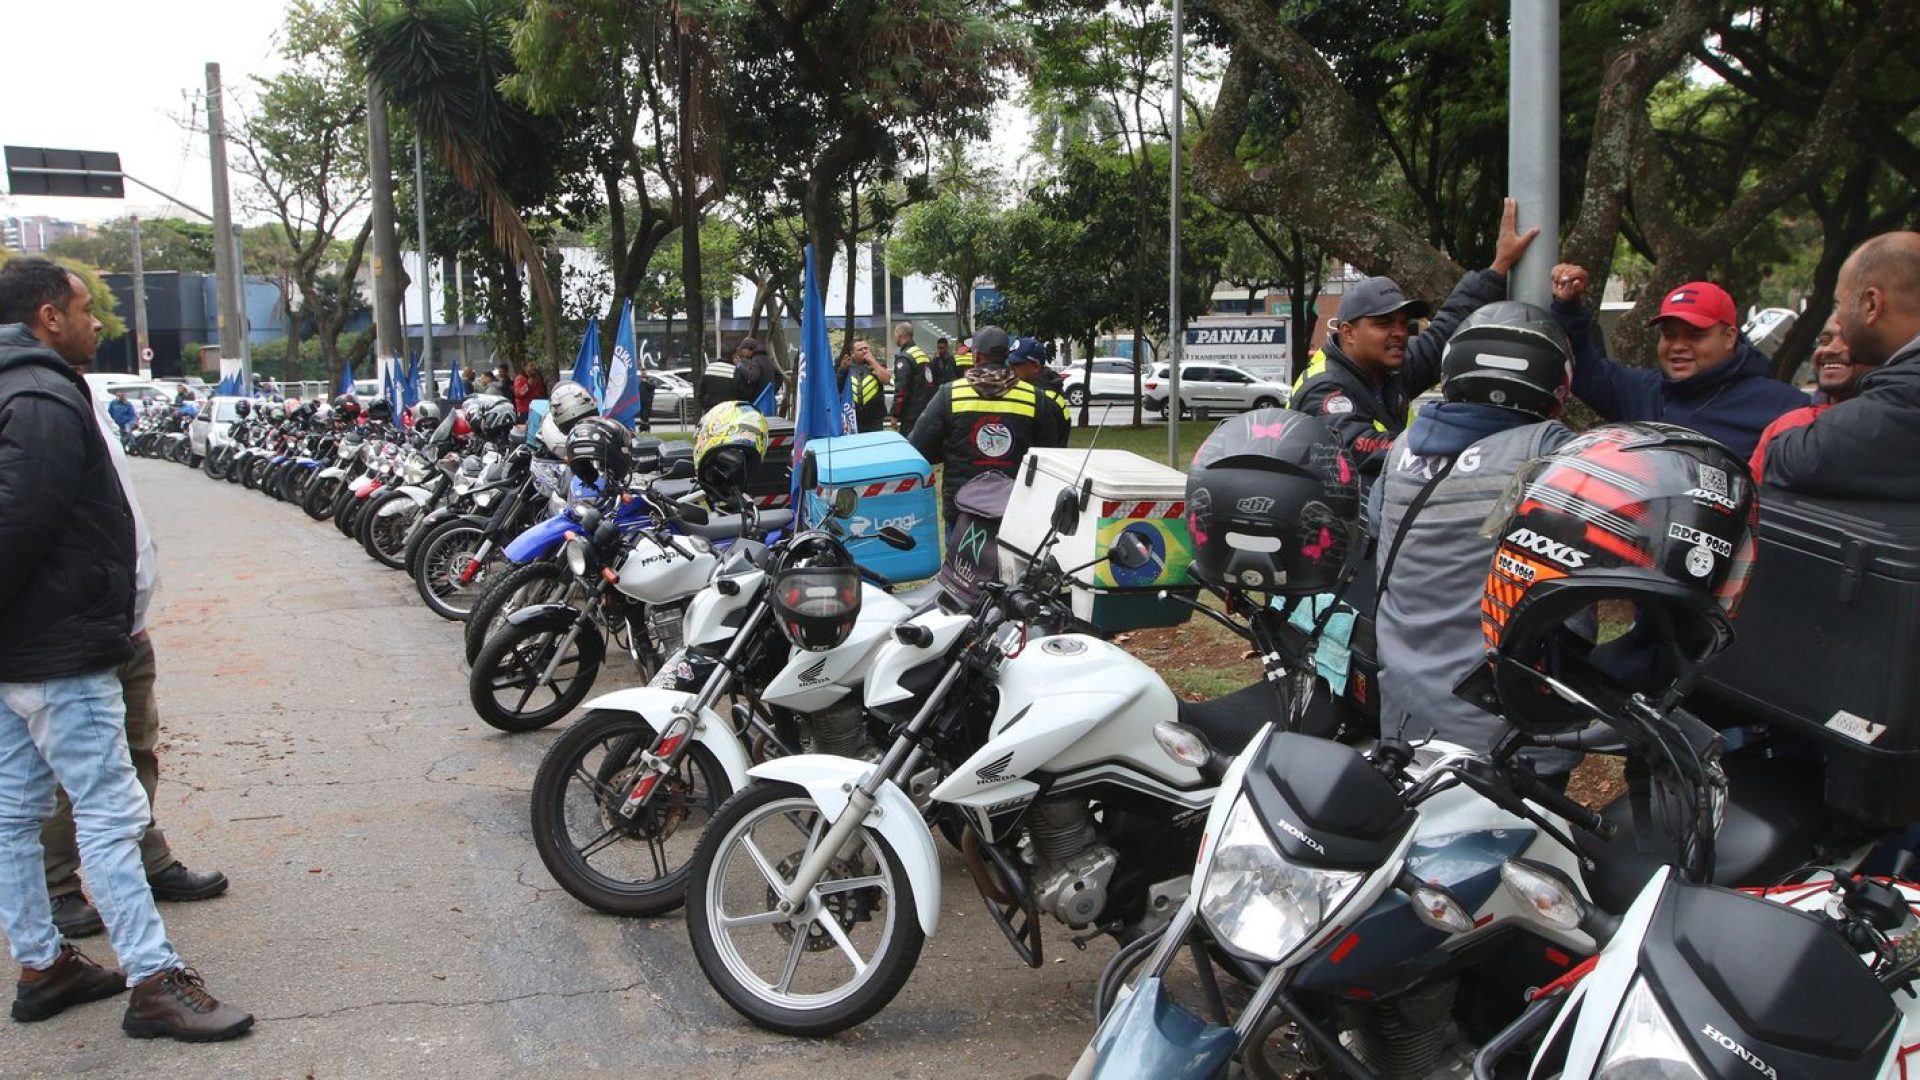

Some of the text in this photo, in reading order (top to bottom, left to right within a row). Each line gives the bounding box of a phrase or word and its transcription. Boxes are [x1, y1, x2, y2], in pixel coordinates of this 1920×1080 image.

[1196, 329, 1275, 343] PANNAN
[1506, 528, 1591, 568] AXXIS
[1670, 525, 1730, 555] RDG 9060
[799, 677, 830, 688] HONDA
[977, 774, 1017, 785] HONDA
[1277, 819, 1325, 855] HONDA
[1701, 1024, 1778, 1080] HONDA
